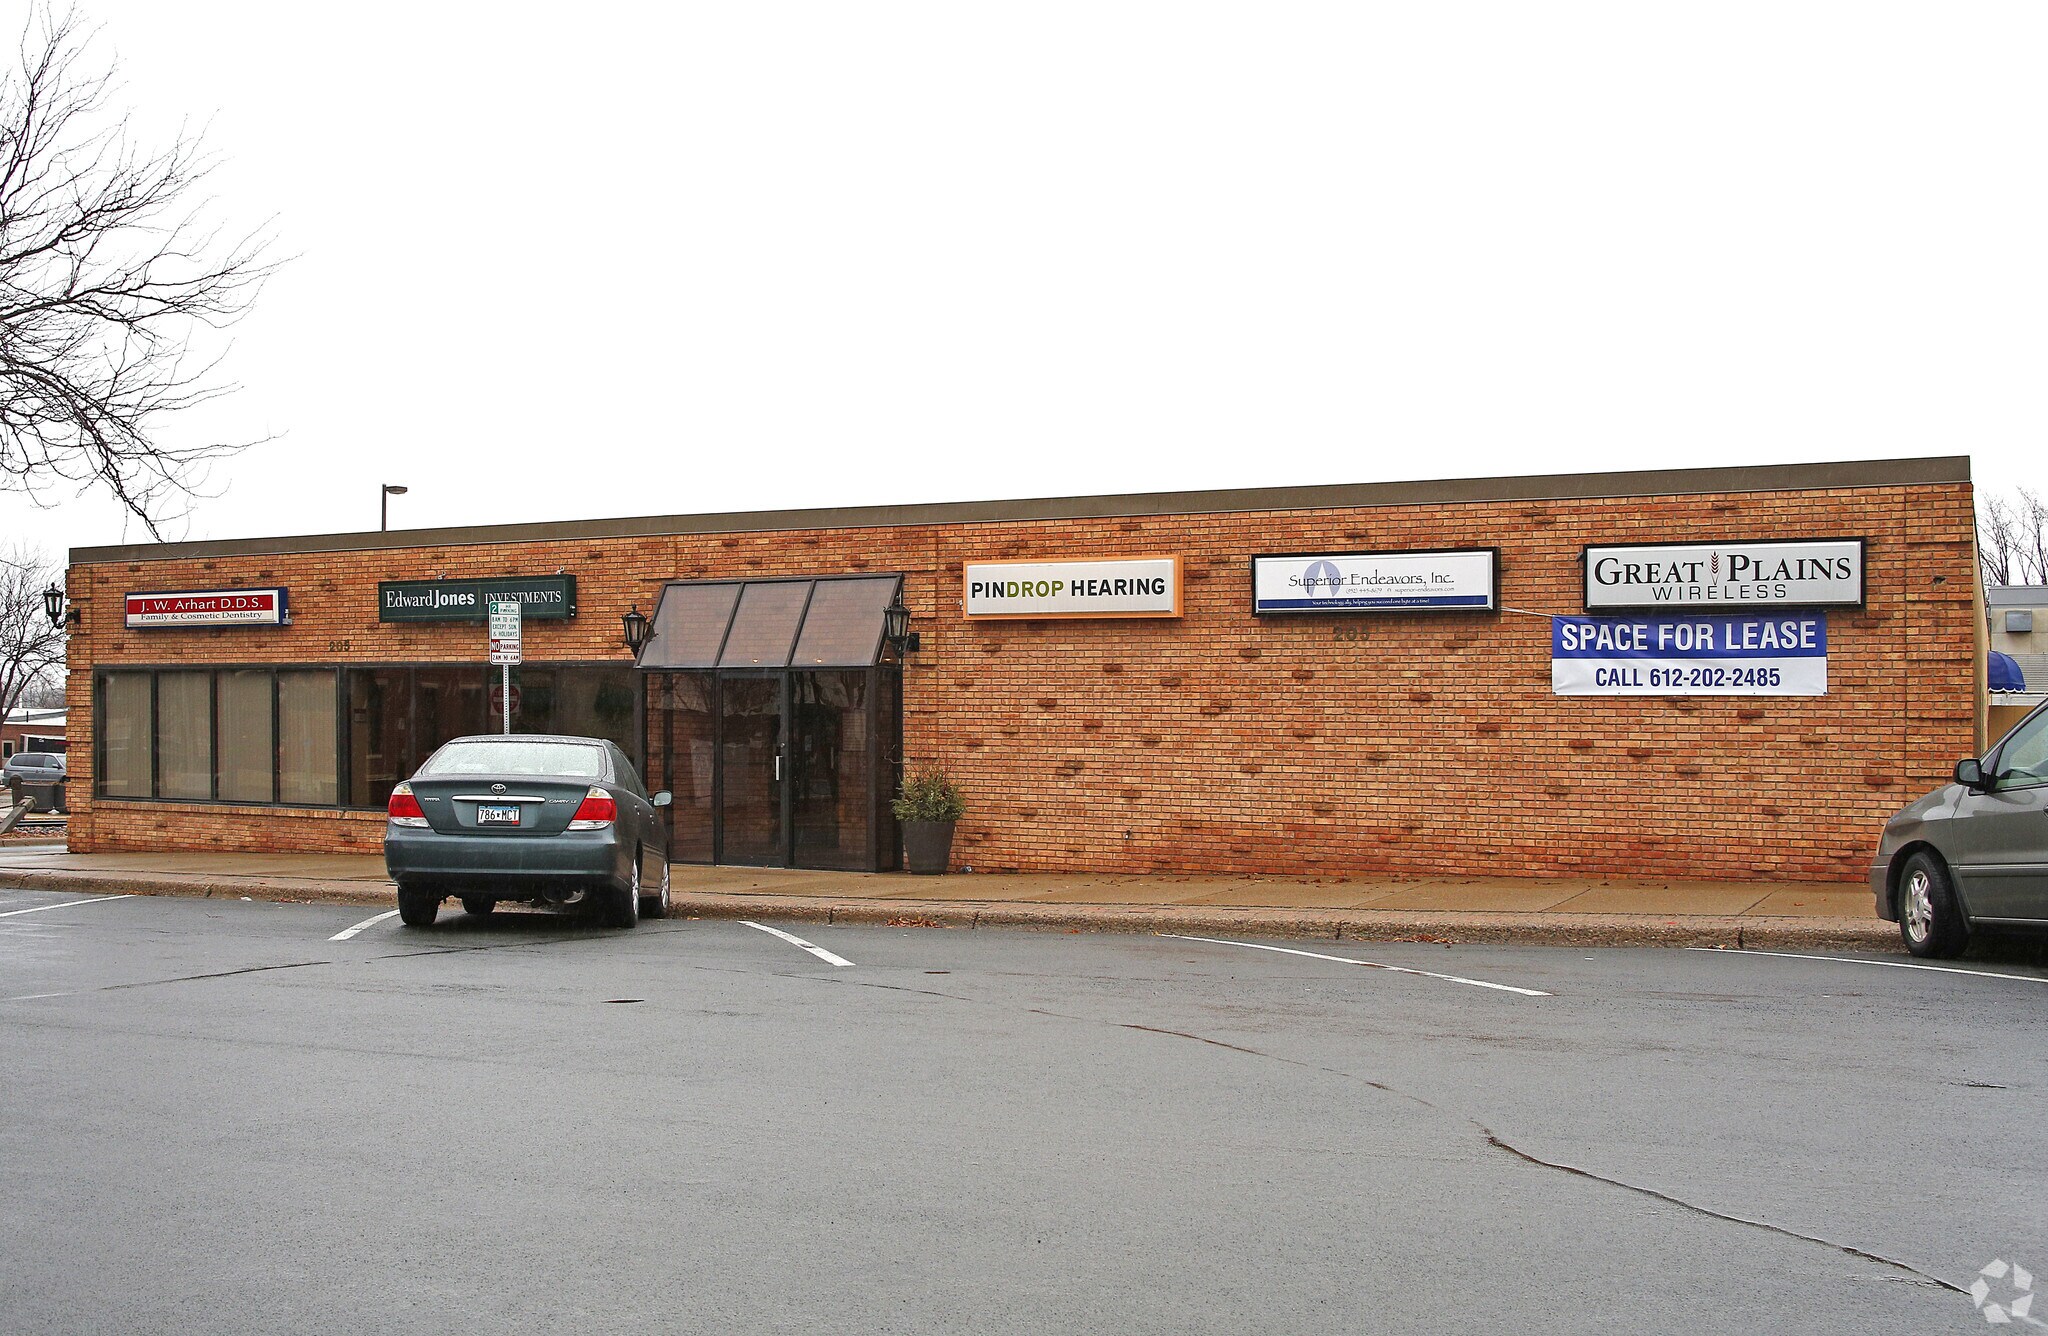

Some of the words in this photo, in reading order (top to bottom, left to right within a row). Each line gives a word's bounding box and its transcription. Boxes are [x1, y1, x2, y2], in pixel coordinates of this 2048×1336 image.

[1594, 557, 1704, 586] GREAT
[1726, 554, 1851, 582] PLAINS
[971, 579, 1064, 598] PINDROP
[1071, 577, 1165, 597] HEARING
[1288, 573, 1347, 594] Superior
[1350, 568, 1427, 587] Endeavors,
[1431, 571, 1455, 584] Inc.
[484, 590, 562, 605] INVESTMENTS
[1652, 584, 1787, 601] WIRELESS
[141, 601, 150, 613] J.
[153, 600, 171, 611] W.
[174, 598, 216, 610] Arhart
[220, 597, 263, 609] D.D.S.
[491, 604, 498, 614] 2
[141, 613, 169, 622] Family
[171, 612, 179, 620] &
[180, 611, 221, 620] Cosmetic
[222, 610, 263, 620] Dentistry
[1561, 623, 1648, 651] SPACE
[1657, 623, 1714, 650] FOR
[1725, 620, 1816, 650] LEASE
[491, 641, 500, 650] NO
[1595, 667, 1643, 687] CALL
[1650, 667, 1781, 687] 612-202-2485
